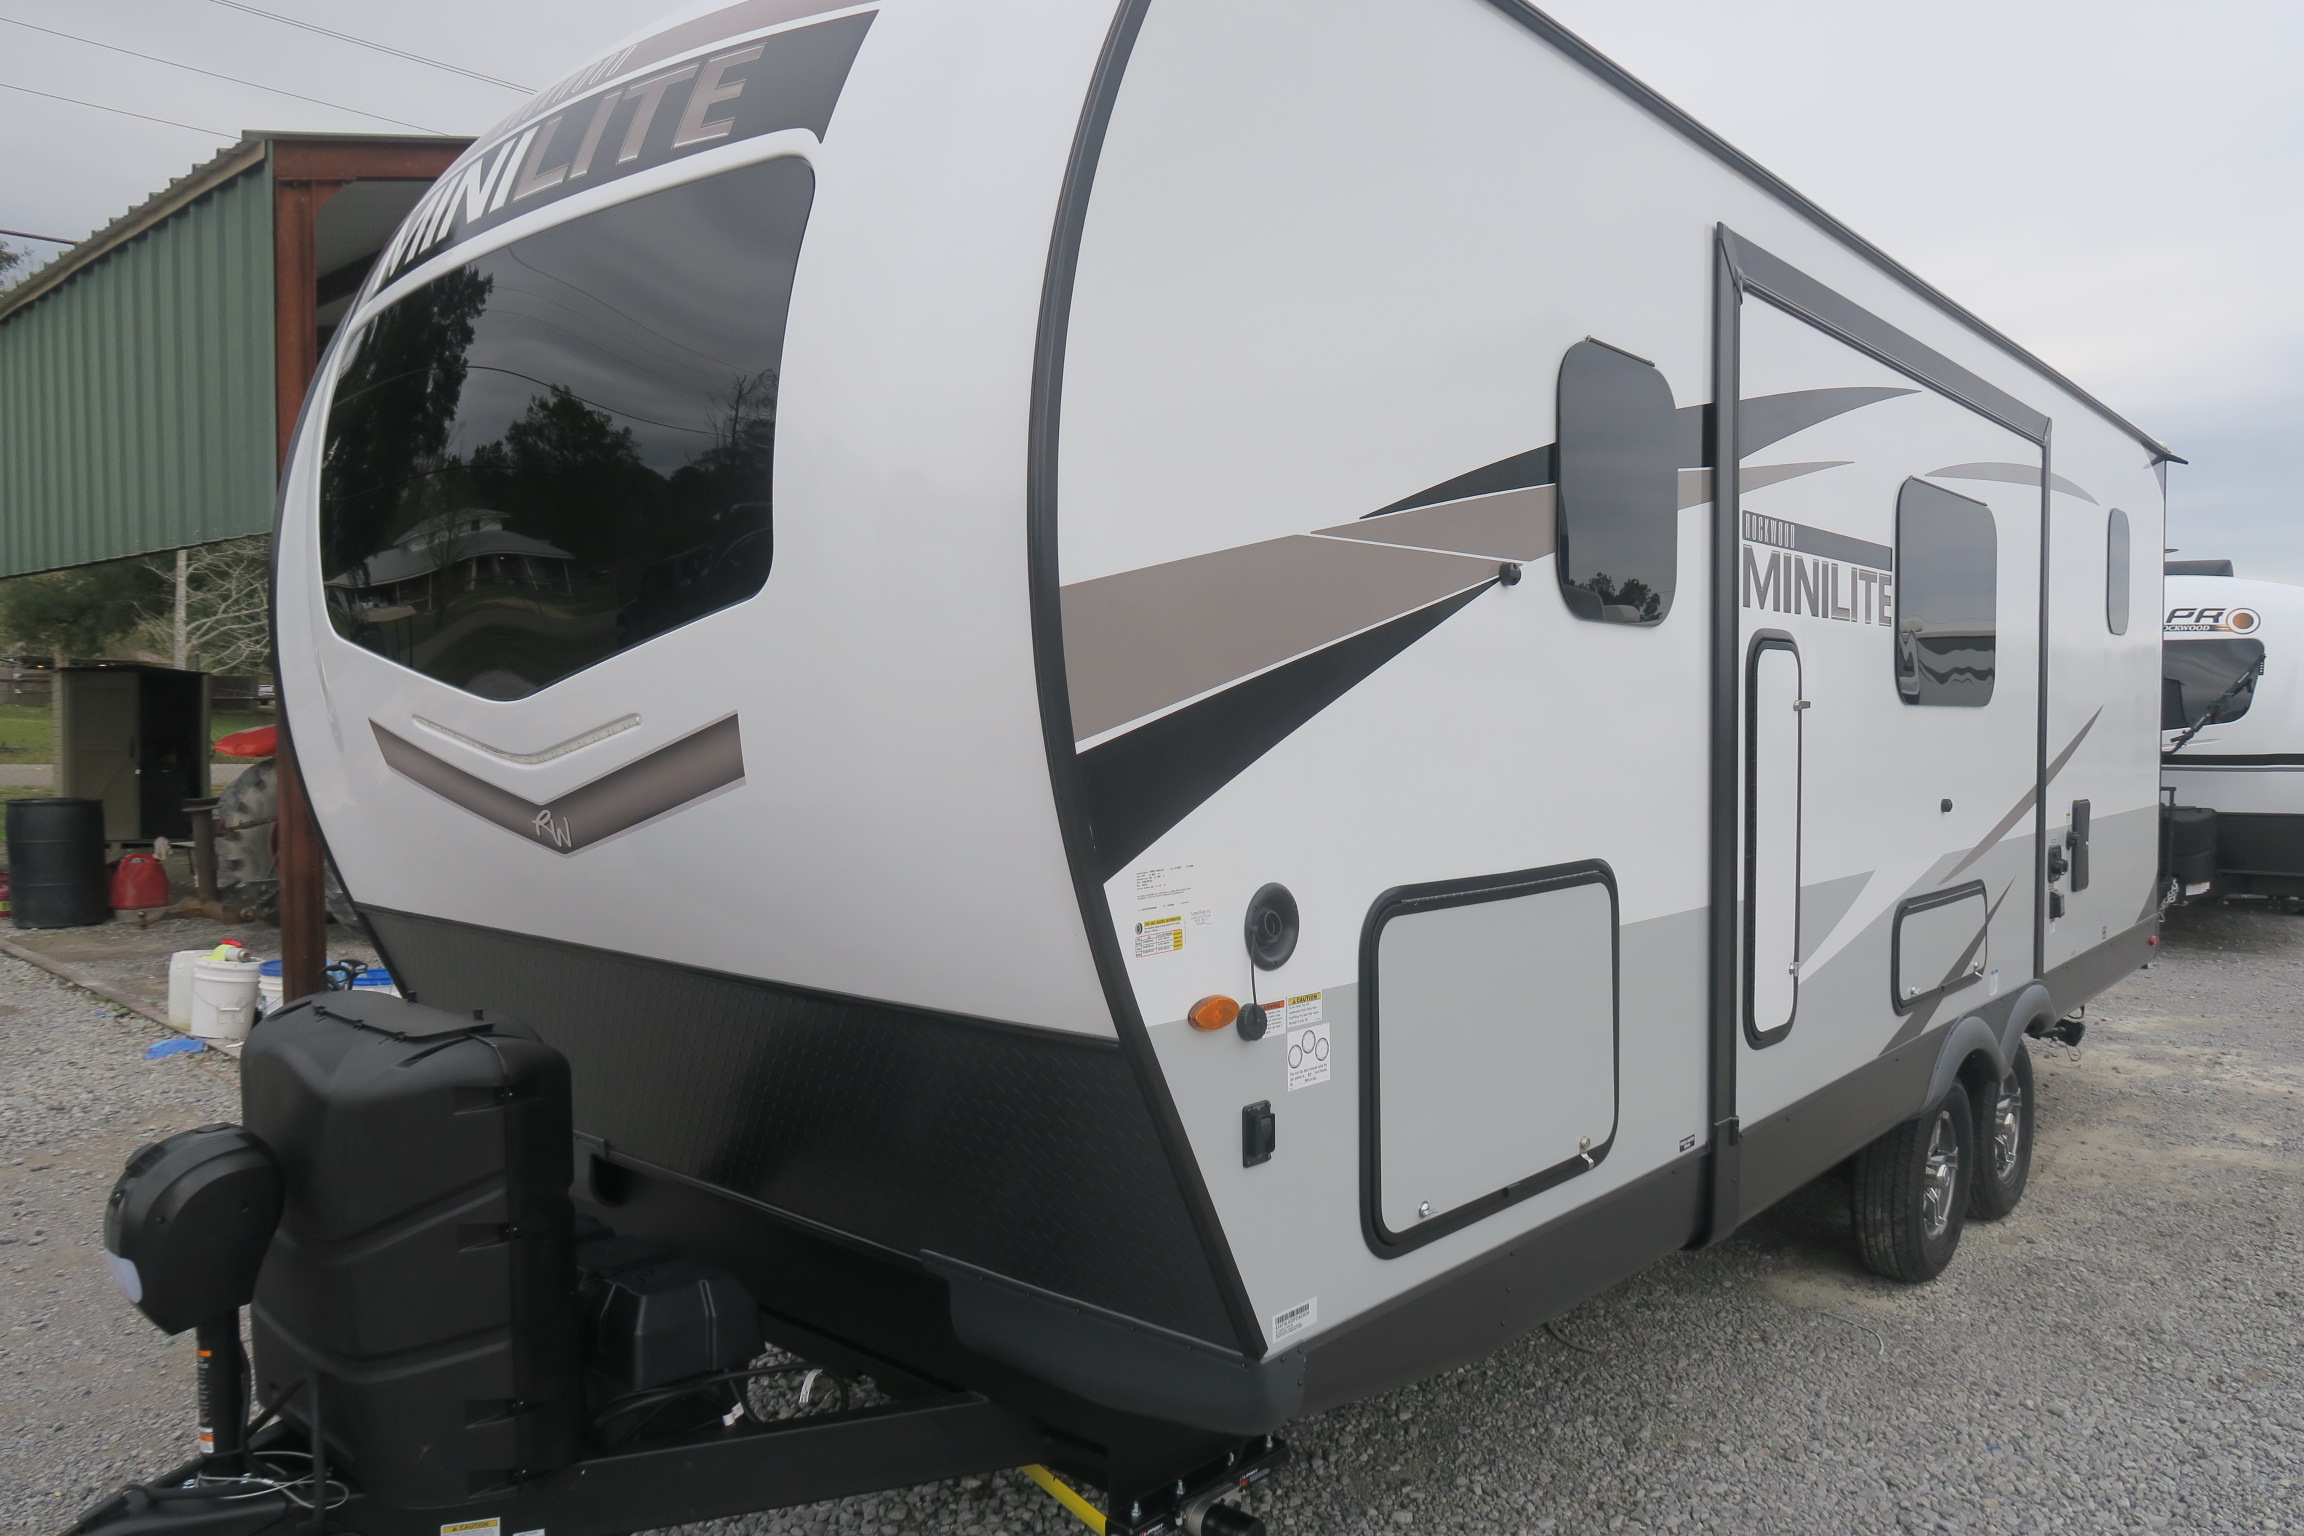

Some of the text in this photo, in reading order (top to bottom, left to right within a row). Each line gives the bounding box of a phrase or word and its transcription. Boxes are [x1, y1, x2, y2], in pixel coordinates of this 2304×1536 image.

[372, 42, 767, 293] MINILITE
[1745, 513, 1796, 549] ROCKWOOD
[1742, 543, 1892, 627] MINILITE
[2163, 624, 2210, 632] OCKWOOD
[532, 809, 572, 848] RW
[1296, 994, 1318, 1003] CAUTION
